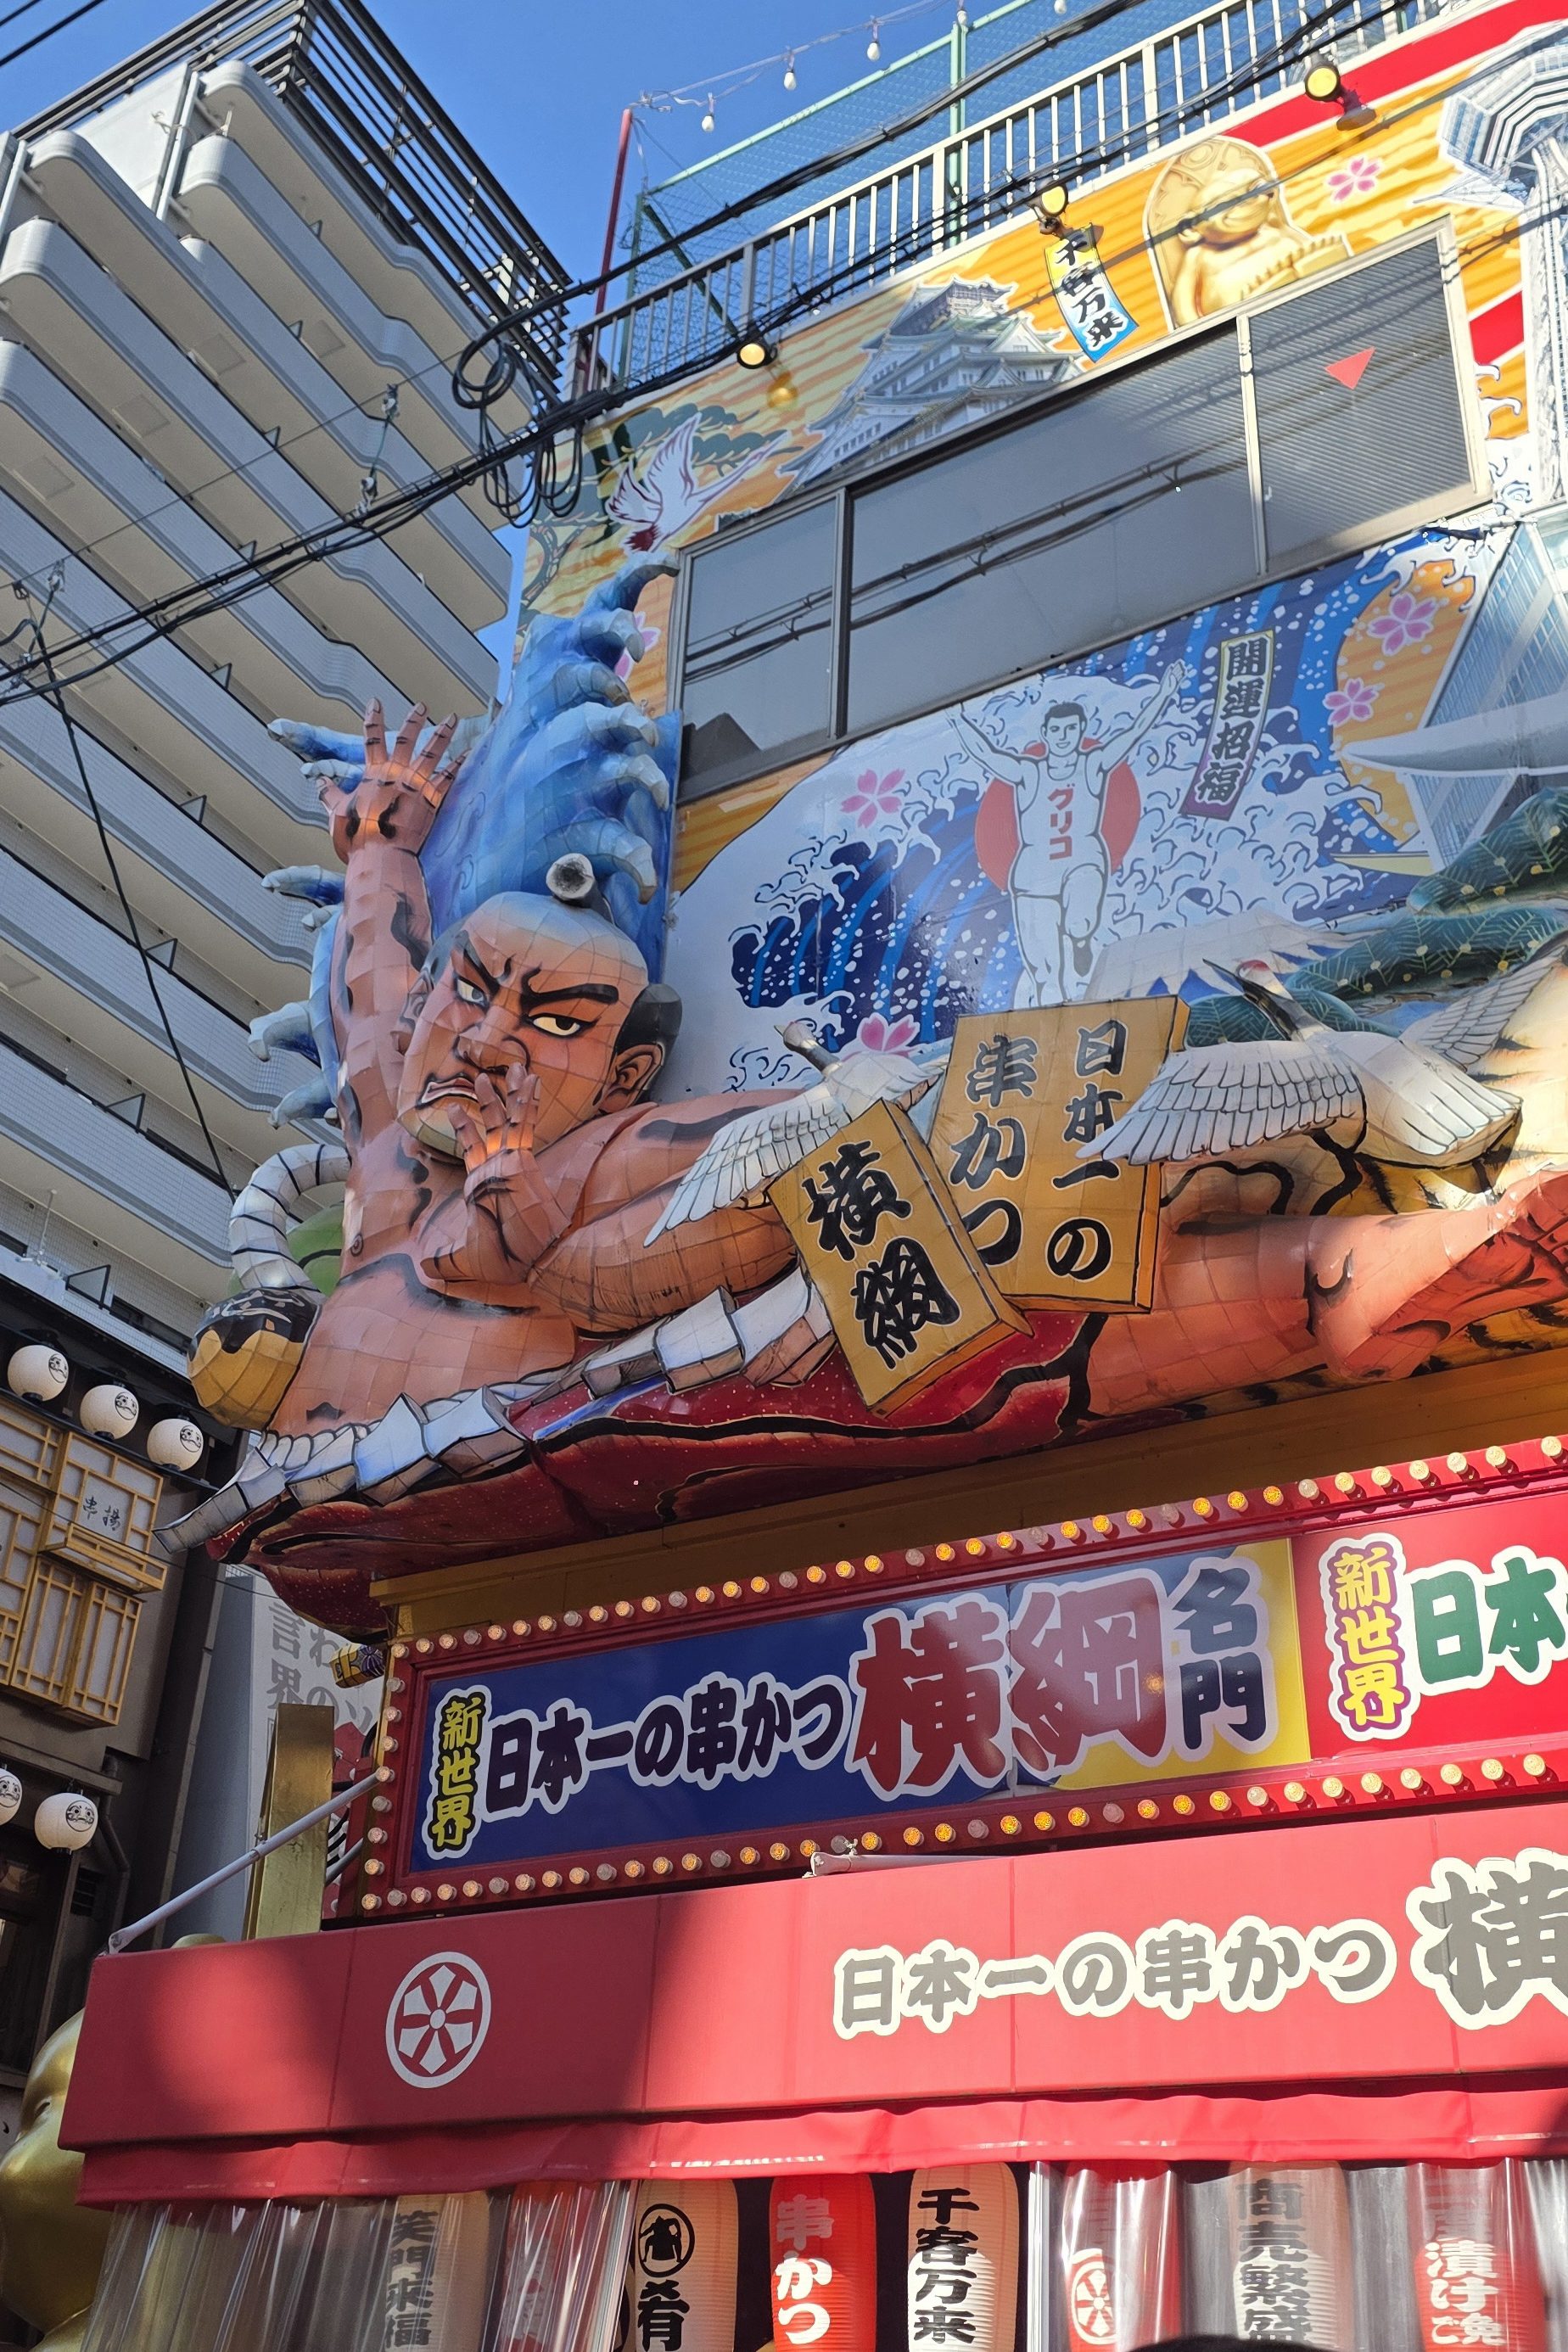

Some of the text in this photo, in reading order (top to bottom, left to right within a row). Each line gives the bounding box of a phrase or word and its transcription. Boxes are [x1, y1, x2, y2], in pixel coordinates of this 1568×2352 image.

[1197, 637, 1268, 803] 開運招福
[1048, 782, 1075, 860] グリコ
[950, 1033, 1038, 1266] 串かつ
[1049, 1020, 1127, 1280] 日本一の
[802, 1141, 960, 1369] 横綱
[484, 1576, 1168, 1813] 日本一の串かつ 横綱
[1173, 1567, 1268, 1750] 名門
[1334, 1546, 1405, 1726] 新世界
[431, 1695, 482, 1848] 新世界
[841, 1925, 1386, 2028] 日本一の串かつ
[638, 2280, 690, 2351] 肴
[775, 2194, 835, 2344] 串かつ
[914, 2187, 979, 2344] 千客万来
[1235, 2178, 1313, 2345] 商売繁盛
